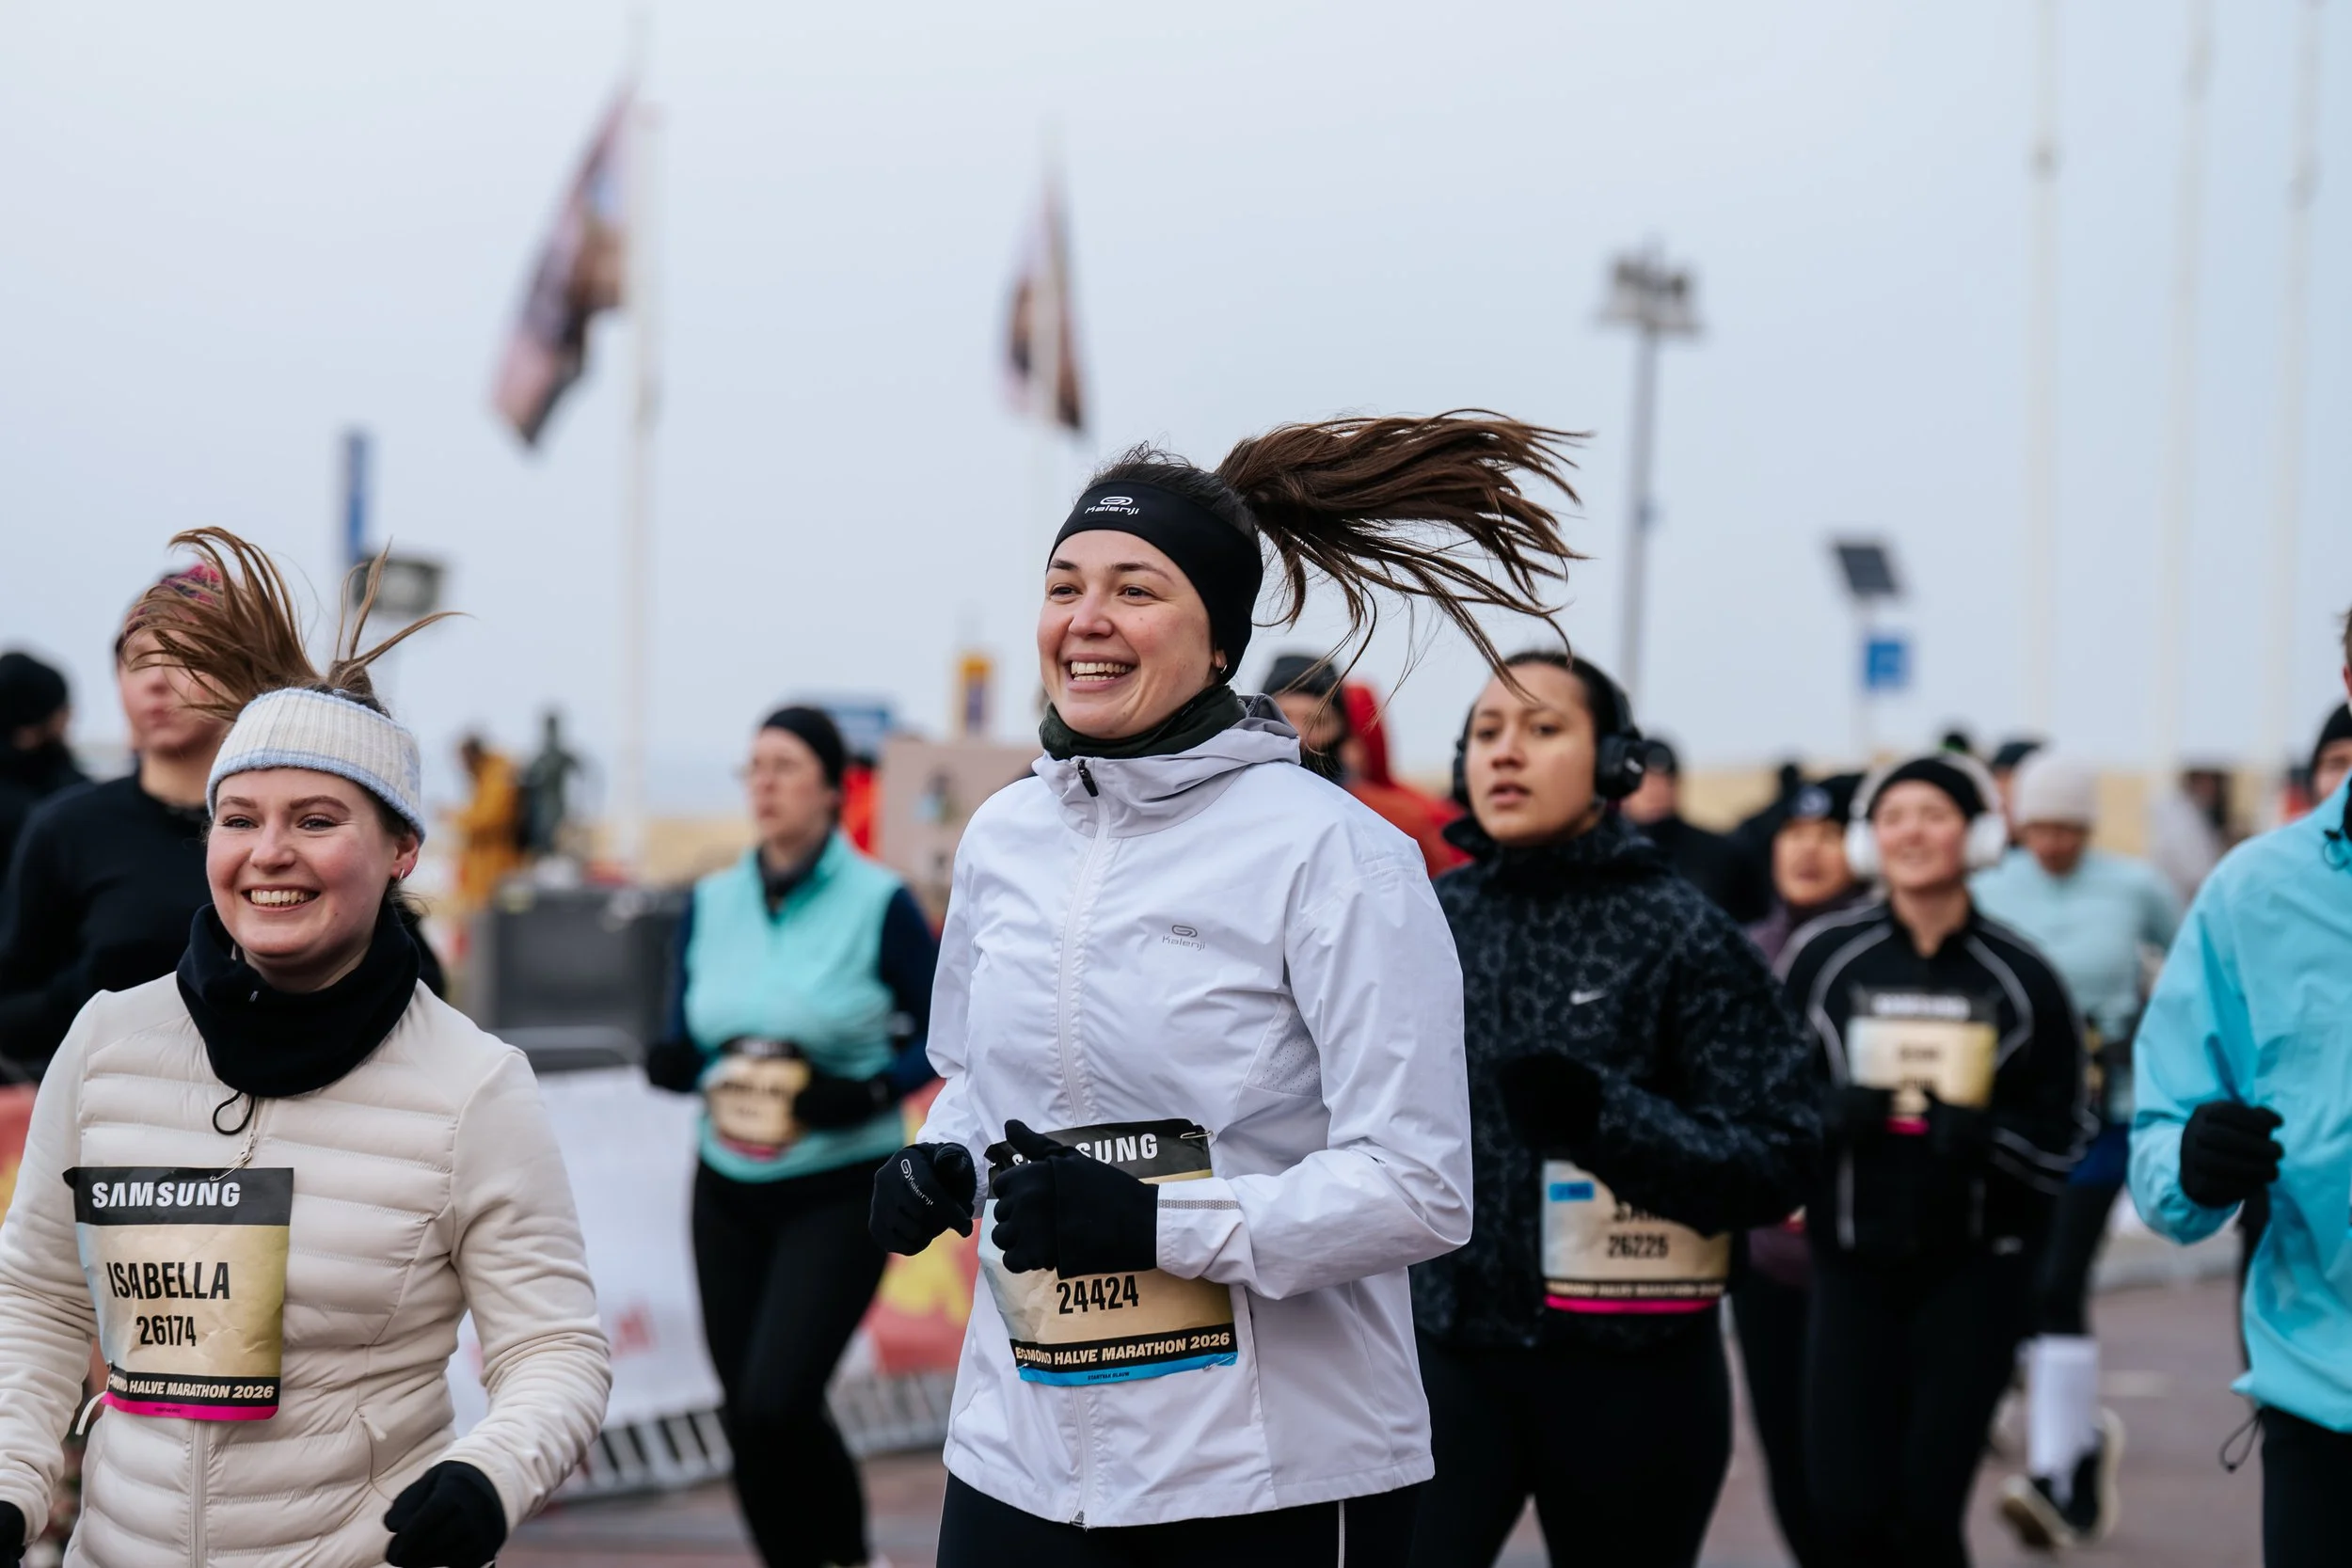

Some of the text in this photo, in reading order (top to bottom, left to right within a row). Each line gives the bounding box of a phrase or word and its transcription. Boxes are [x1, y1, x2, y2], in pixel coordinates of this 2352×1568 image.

[1162, 935, 1205, 951] Kalenji
[91, 1181, 241, 1208] SAMSUNG
[106, 1261, 230, 1299] ISABELLA
[1057, 1275, 1139, 1315] 24424
[135, 1316, 197, 1346] 26174
[1015, 1332, 1231, 1365] EGMOND HALVE MARATHON 2026
[129, 1380, 166, 1395] HALVE
[166, 1382, 230, 1398] MARATHON
[231, 1386, 275, 1399] 2026
